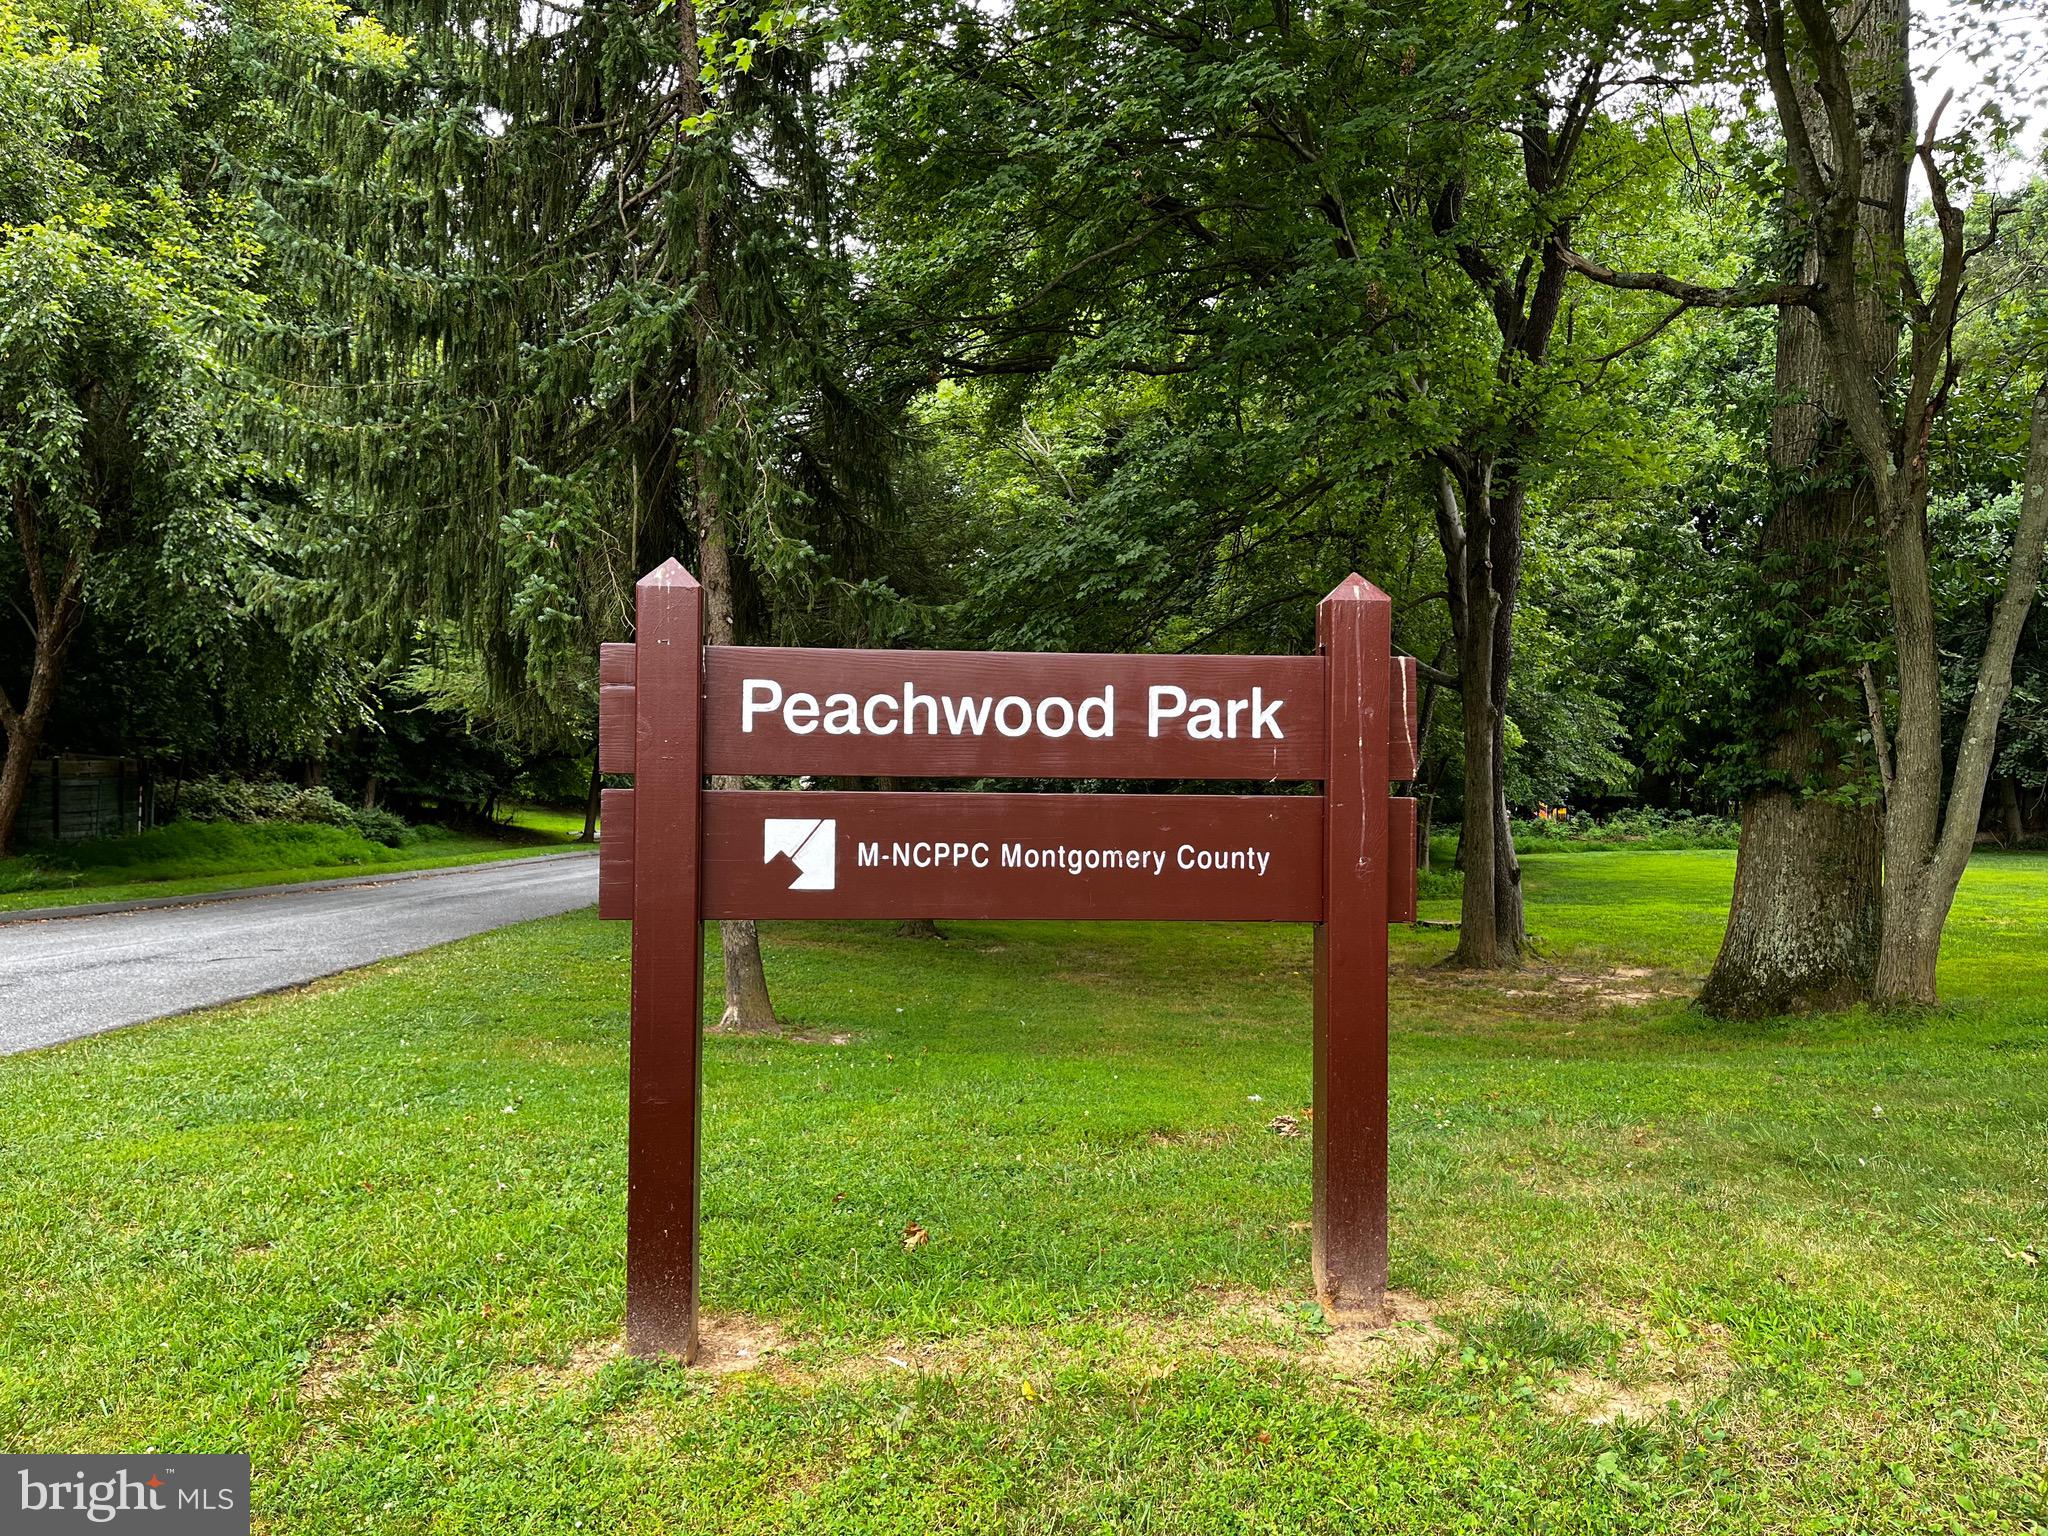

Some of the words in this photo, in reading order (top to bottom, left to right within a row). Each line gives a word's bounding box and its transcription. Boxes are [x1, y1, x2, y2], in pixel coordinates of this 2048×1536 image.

[741, 678, 1115, 739] Peachwood
[1148, 685, 1286, 740] Park
[858, 842, 990, 869] M-NCPPC
[1001, 843, 1166, 876] Montgomery
[1177, 844, 1271, 877] County
